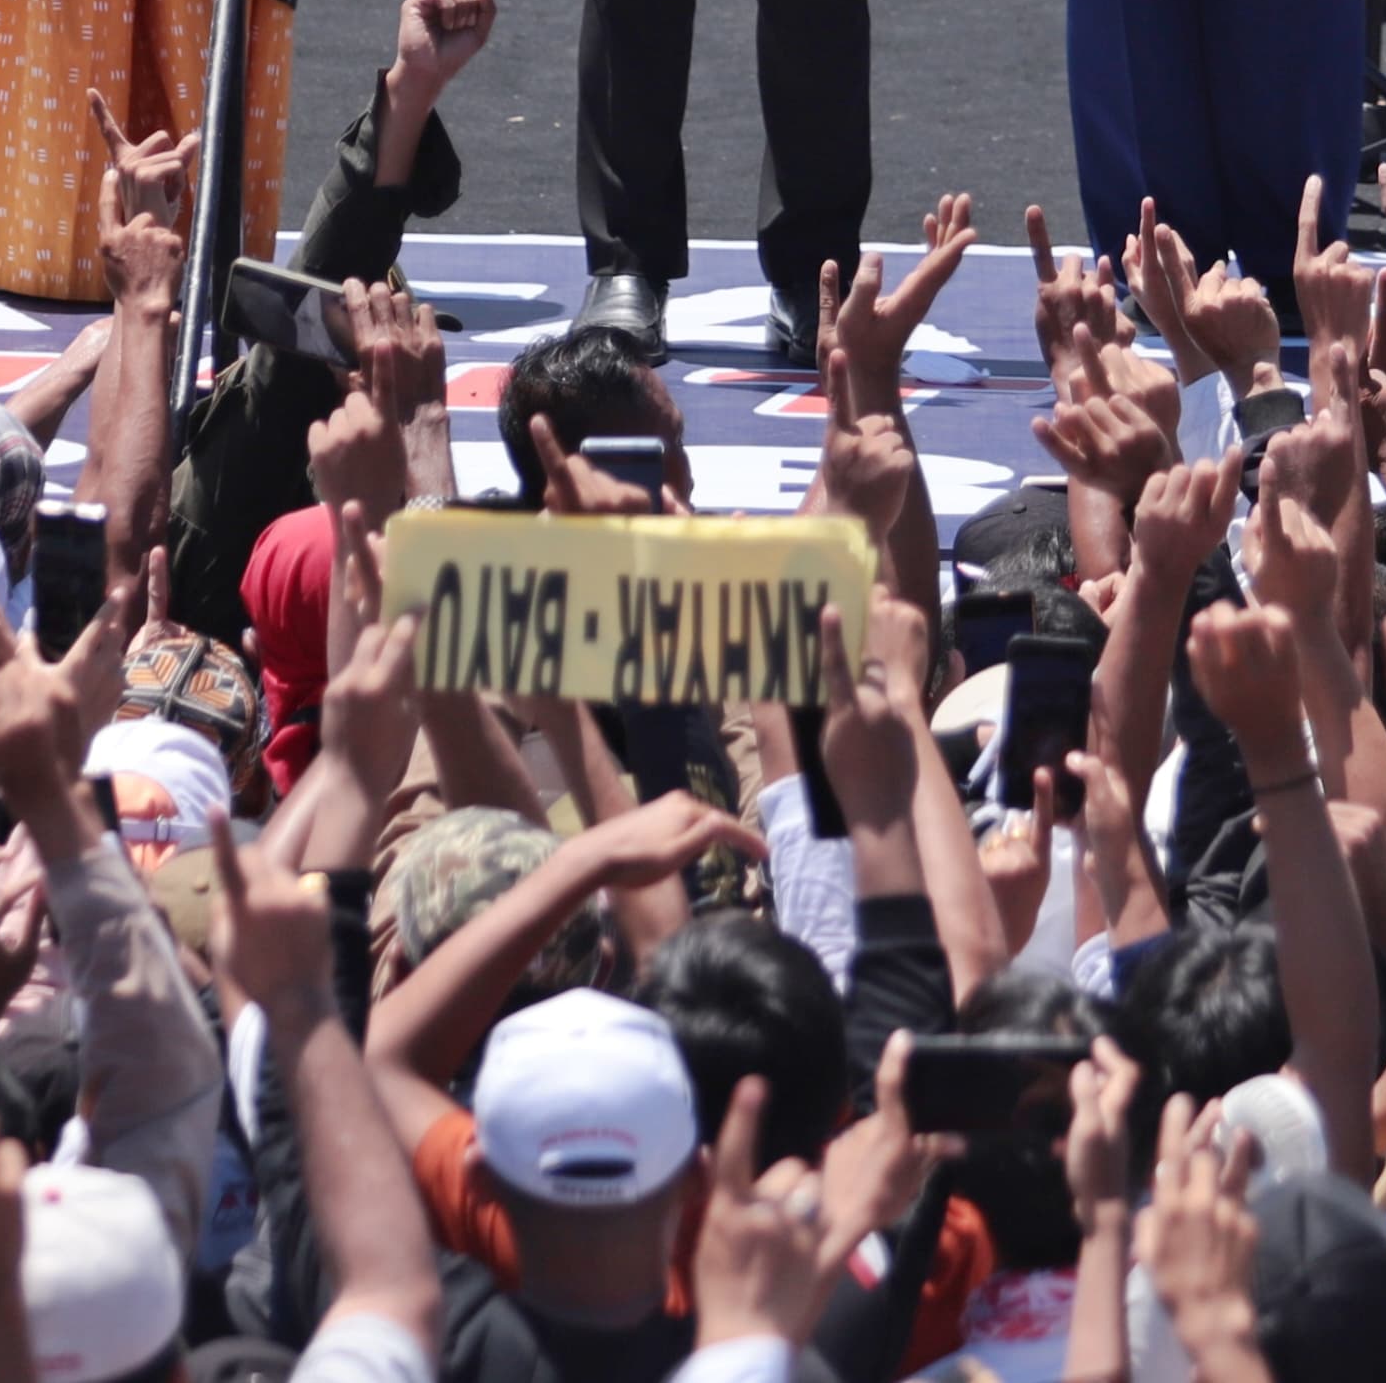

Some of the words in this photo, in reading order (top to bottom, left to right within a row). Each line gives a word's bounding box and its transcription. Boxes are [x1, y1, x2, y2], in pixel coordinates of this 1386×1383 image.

[424, 560, 569, 700] BAYU
[583, 609, 600, 643] -
[615, 574, 830, 706] AKHYAR
